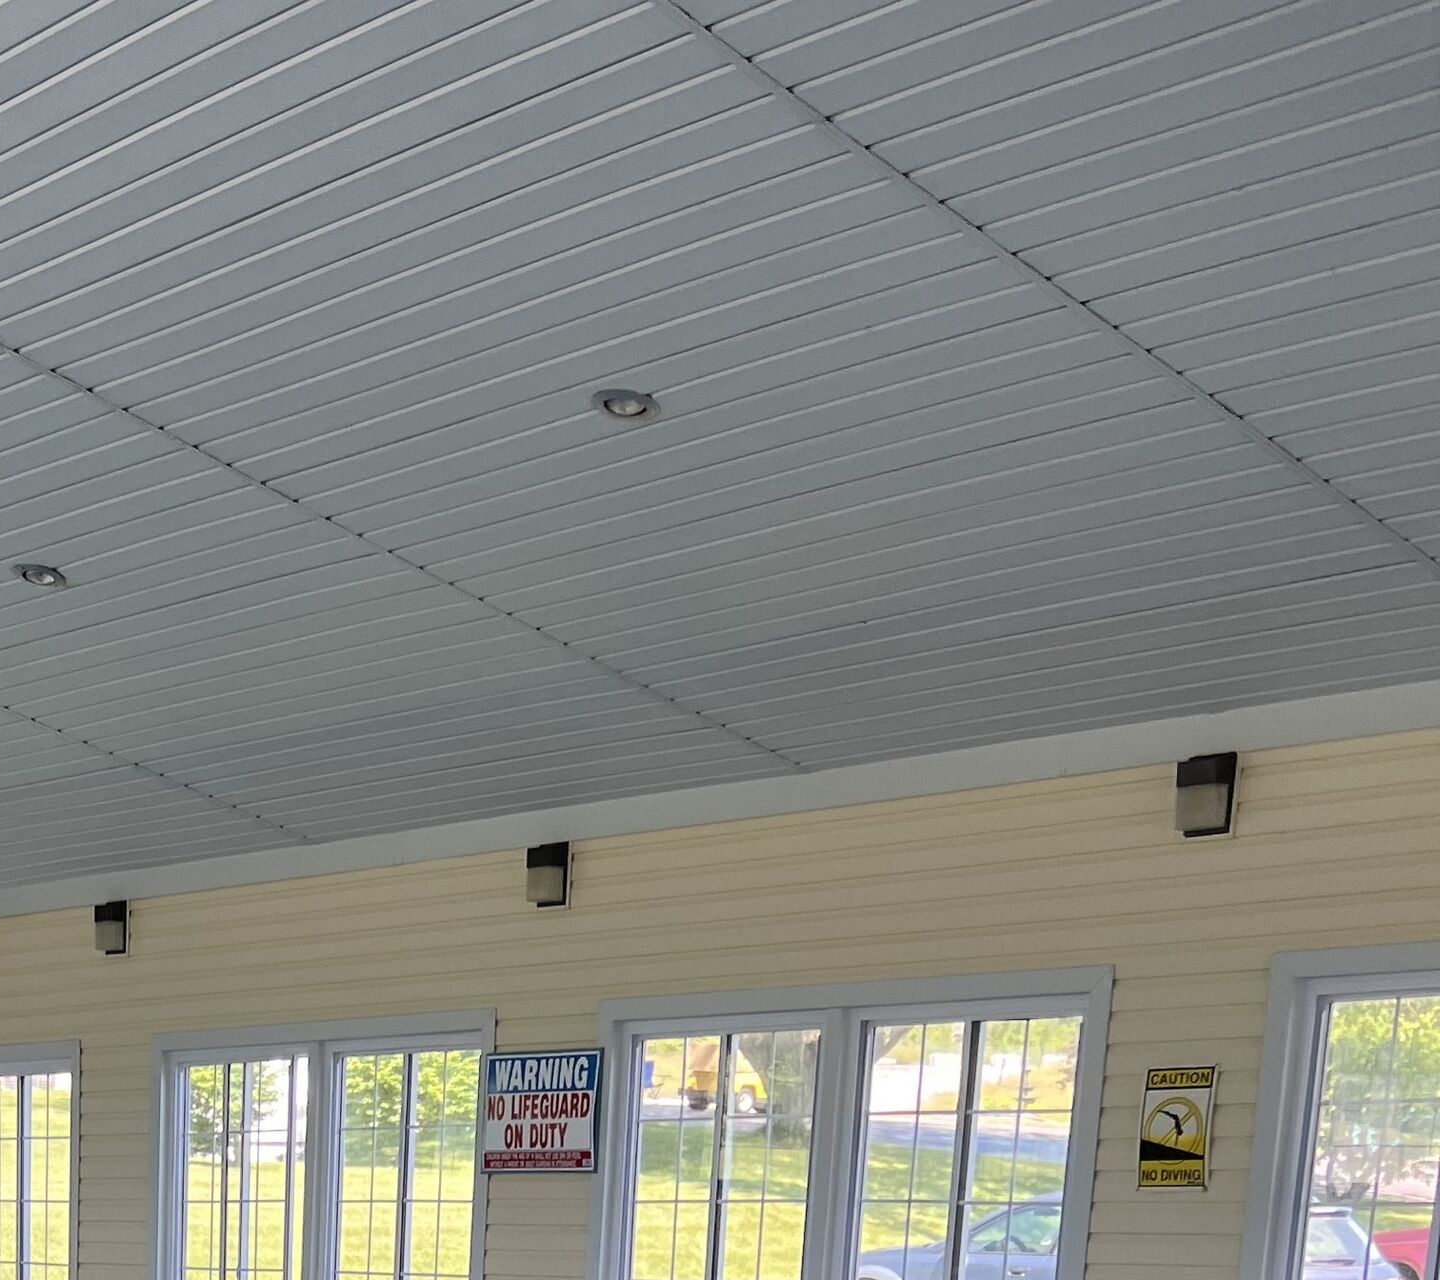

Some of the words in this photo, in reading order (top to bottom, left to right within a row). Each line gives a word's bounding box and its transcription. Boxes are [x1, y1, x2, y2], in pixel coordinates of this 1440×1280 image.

[495, 1056, 589, 1091] WARNING
[1150, 1071, 1210, 1085] CAUTION
[487, 1095, 505, 1121] NO
[511, 1092, 591, 1120] LIFEGUARD
[504, 1123, 523, 1149] ON
[529, 1122, 568, 1148] DUTY
[1141, 1169, 1158, 1181] NO
[1160, 1169, 1201, 1181] DIVING
